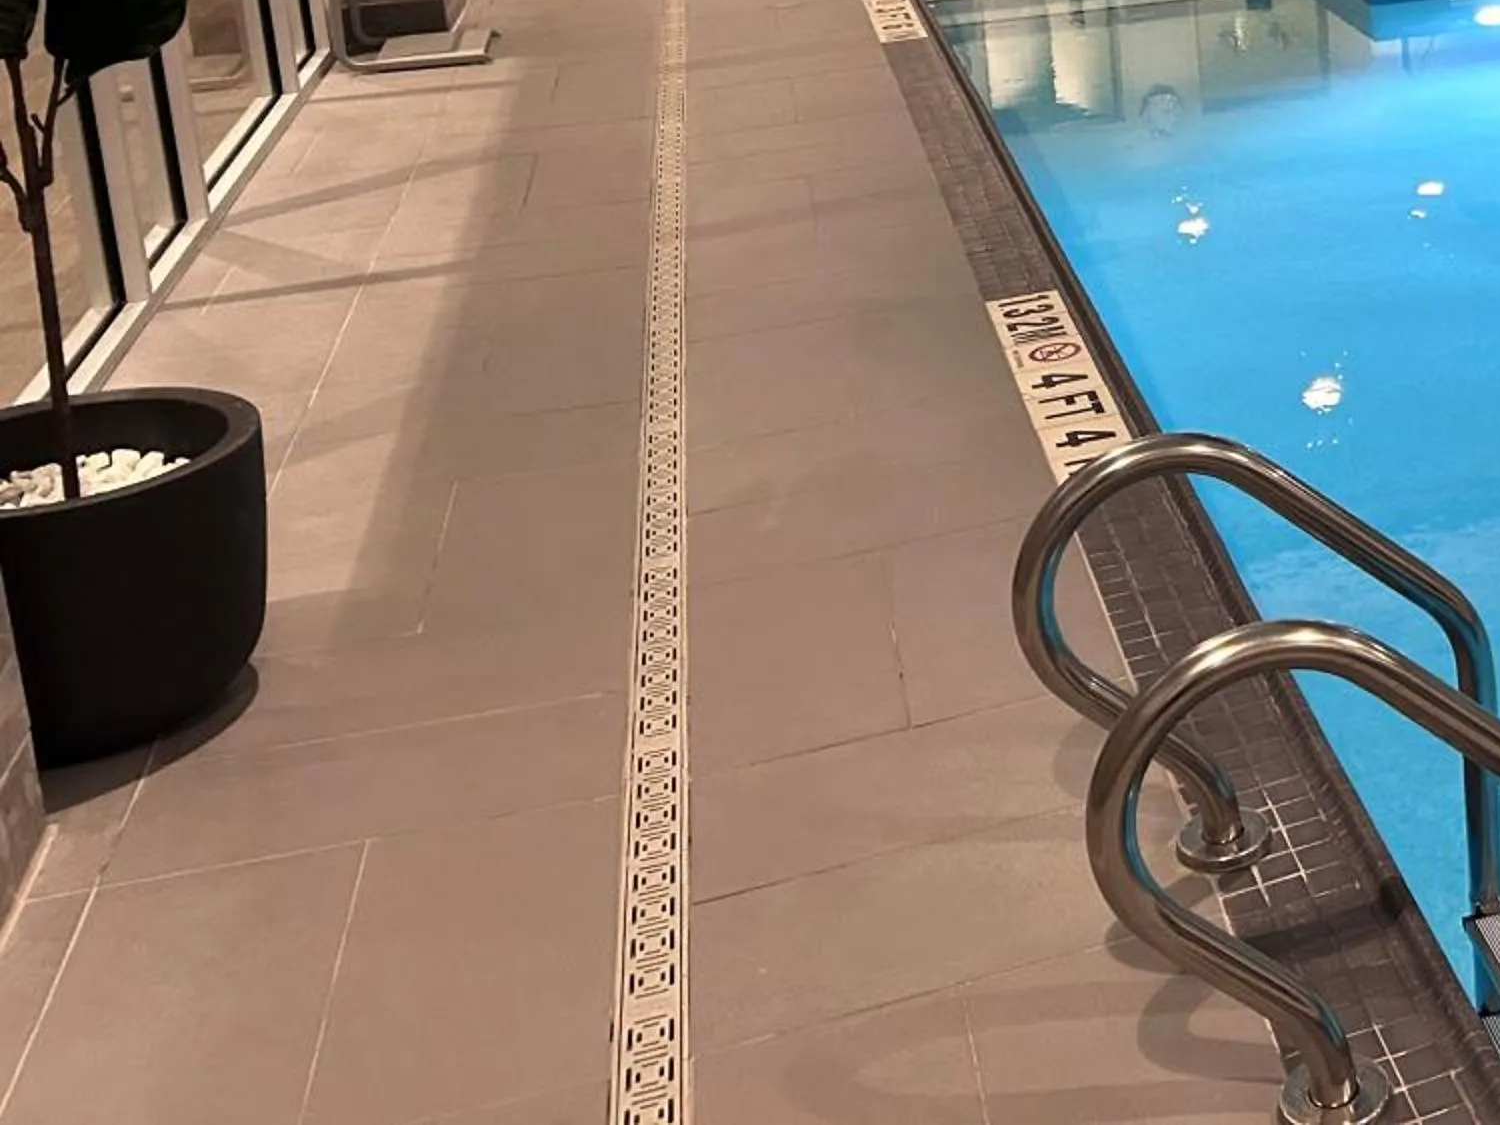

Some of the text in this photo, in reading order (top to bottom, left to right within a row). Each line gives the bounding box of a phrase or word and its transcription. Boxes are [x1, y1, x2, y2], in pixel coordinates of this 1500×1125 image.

[1031, 373, 1089, 390] 4
[1039, 390, 1105, 420] FT
[1055, 430, 1117, 448] 4
